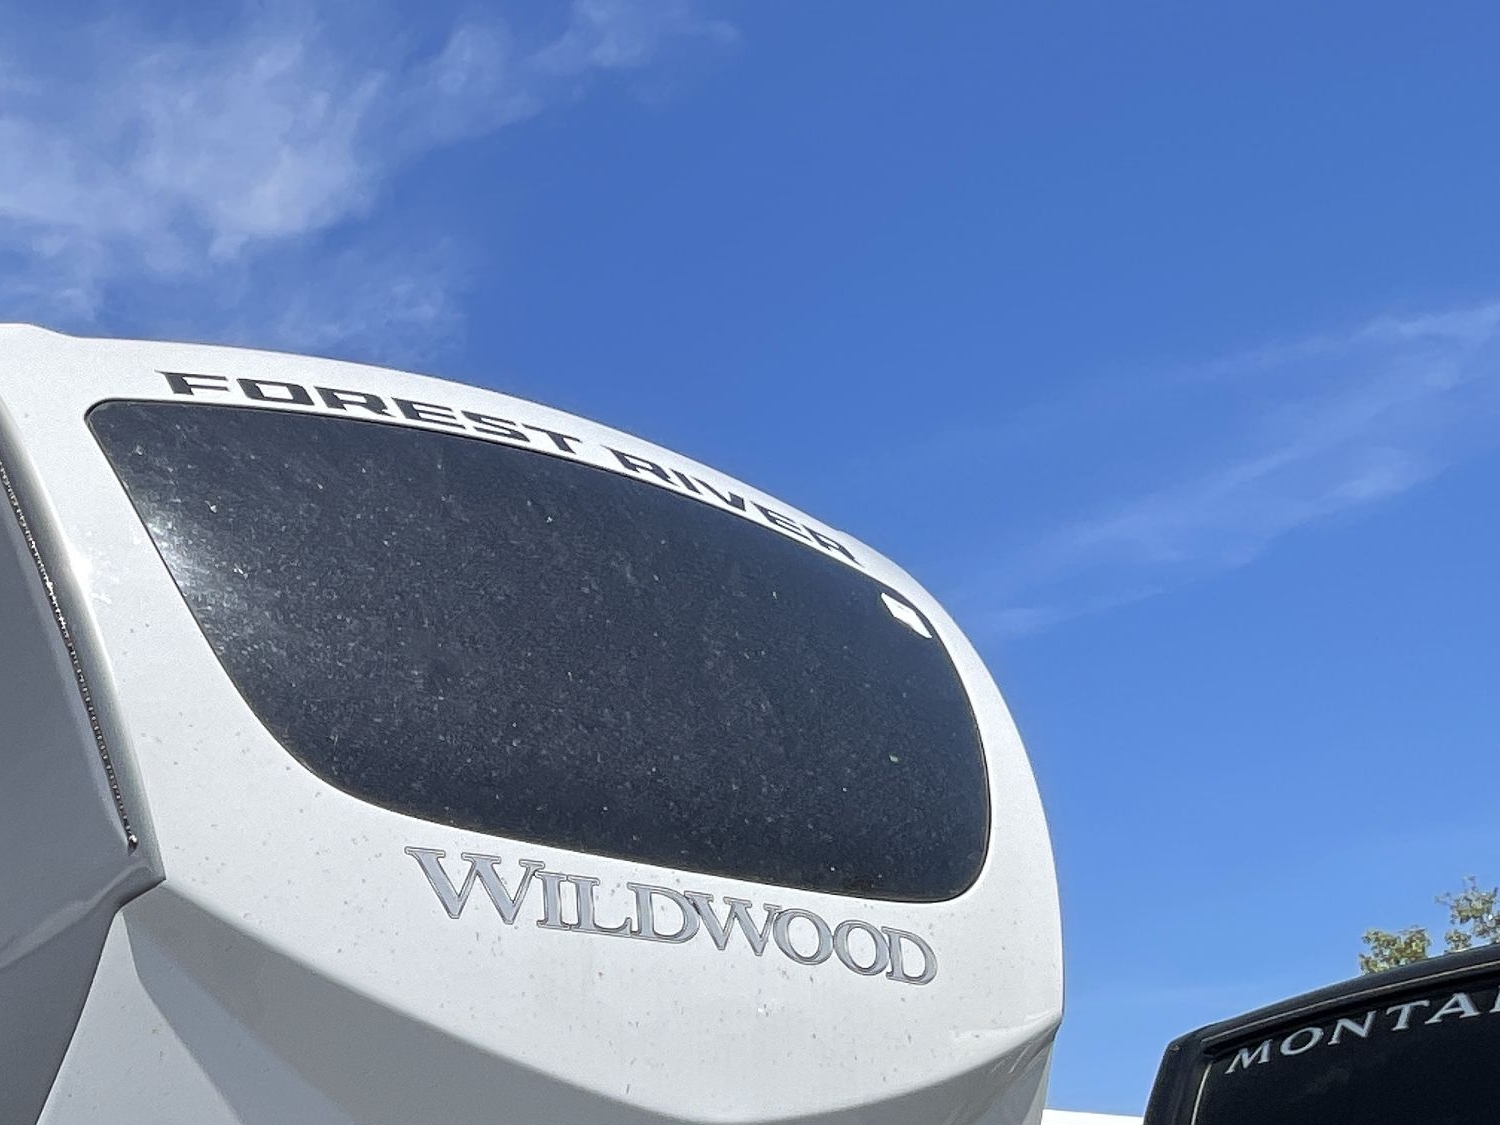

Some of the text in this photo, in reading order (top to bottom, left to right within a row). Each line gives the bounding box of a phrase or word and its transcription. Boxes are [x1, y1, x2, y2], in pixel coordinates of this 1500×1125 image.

[154, 370, 866, 568] FOREST RIVER
[404, 846, 937, 986] WILDWOOD
[1224, 985, 1500, 1075] MONTA
